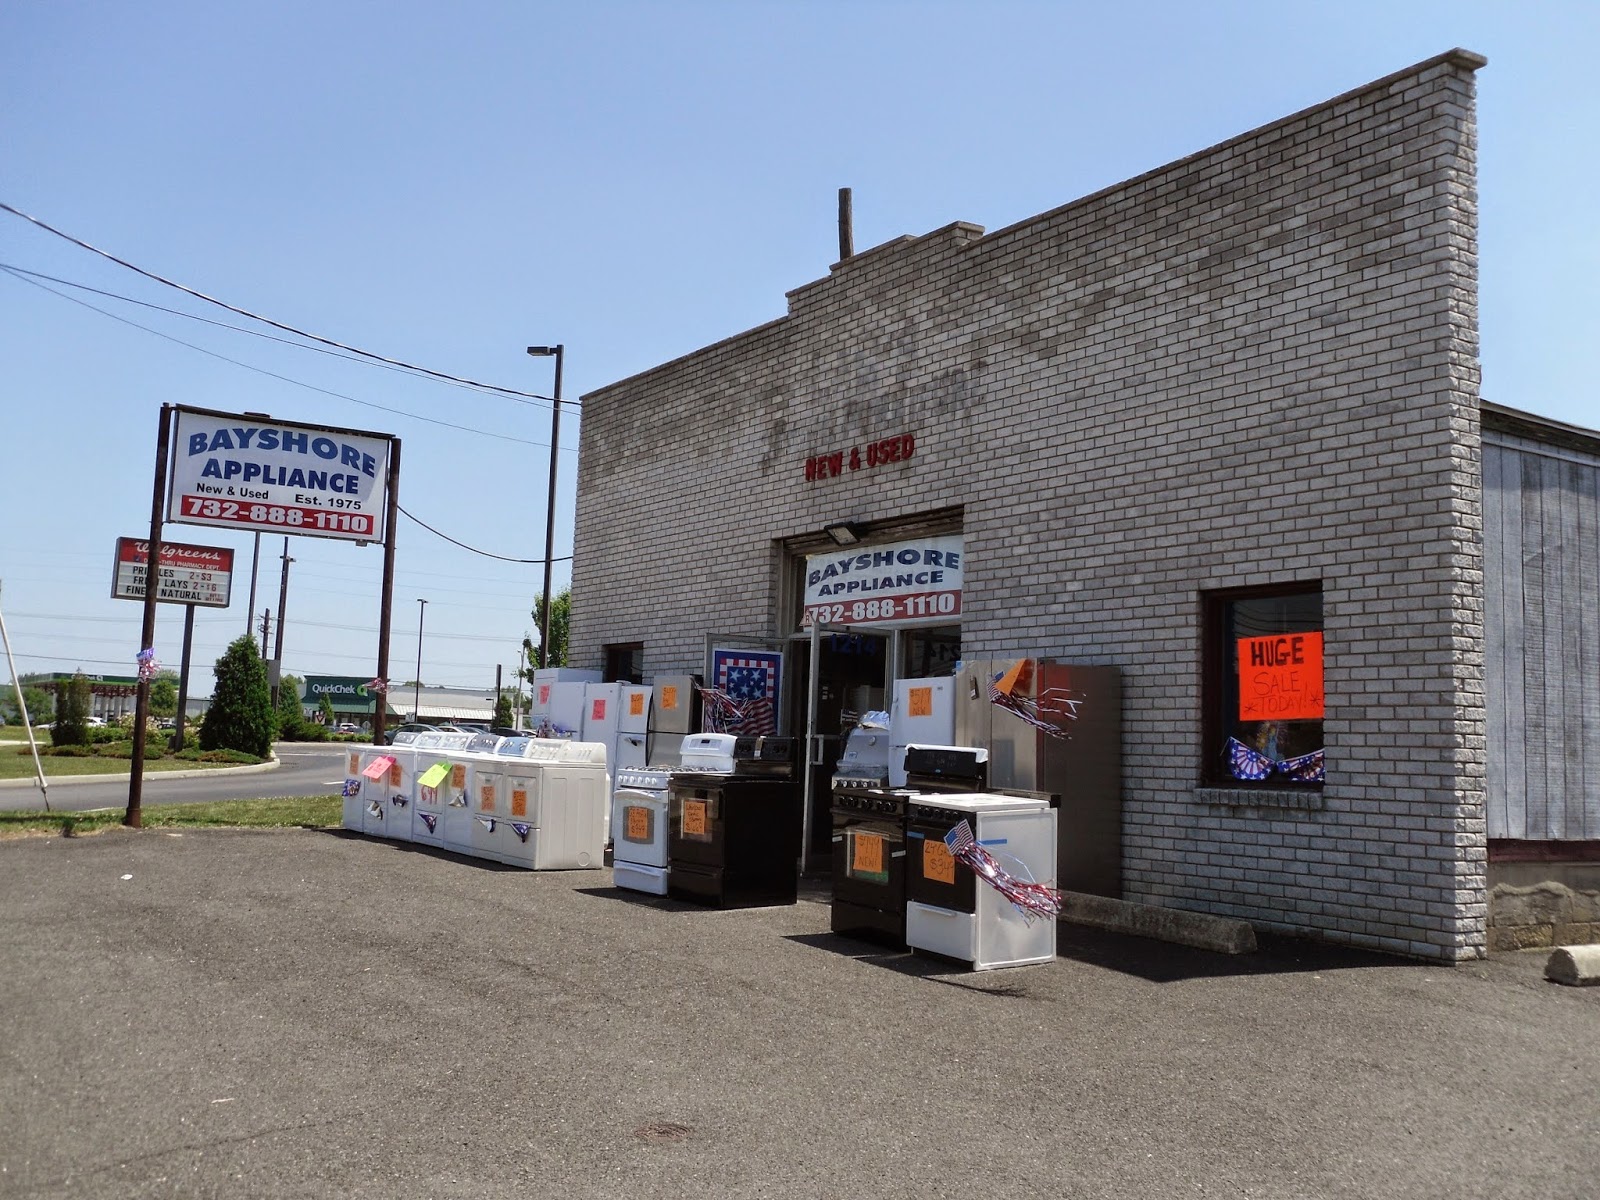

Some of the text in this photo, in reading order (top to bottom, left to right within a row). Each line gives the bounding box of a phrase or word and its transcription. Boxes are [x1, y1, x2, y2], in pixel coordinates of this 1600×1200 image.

[188, 428, 376, 478] BAYSHORE
[805, 433, 915, 481] NEW & USED
[201, 457, 359, 494] APPLIANCE
[196, 482, 362, 510] New & Used Est. 1975
[188, 498, 368, 532] 732-888-1110
[134, 541, 221, 560] Wlgreens
[132, 565, 174, 578] PRILES
[808, 549, 960, 587] BAYSHORE
[160, 588, 201, 600] NATURAL
[165, 579, 188, 589] LAYS
[818, 570, 944, 597] APPLIANCE
[809, 593, 955, 623] 732-888-1110
[1250, 637, 1304, 667] HUGE
[312, 683, 356, 694] QuickChek
[1253, 670, 1301, 696] SALE
